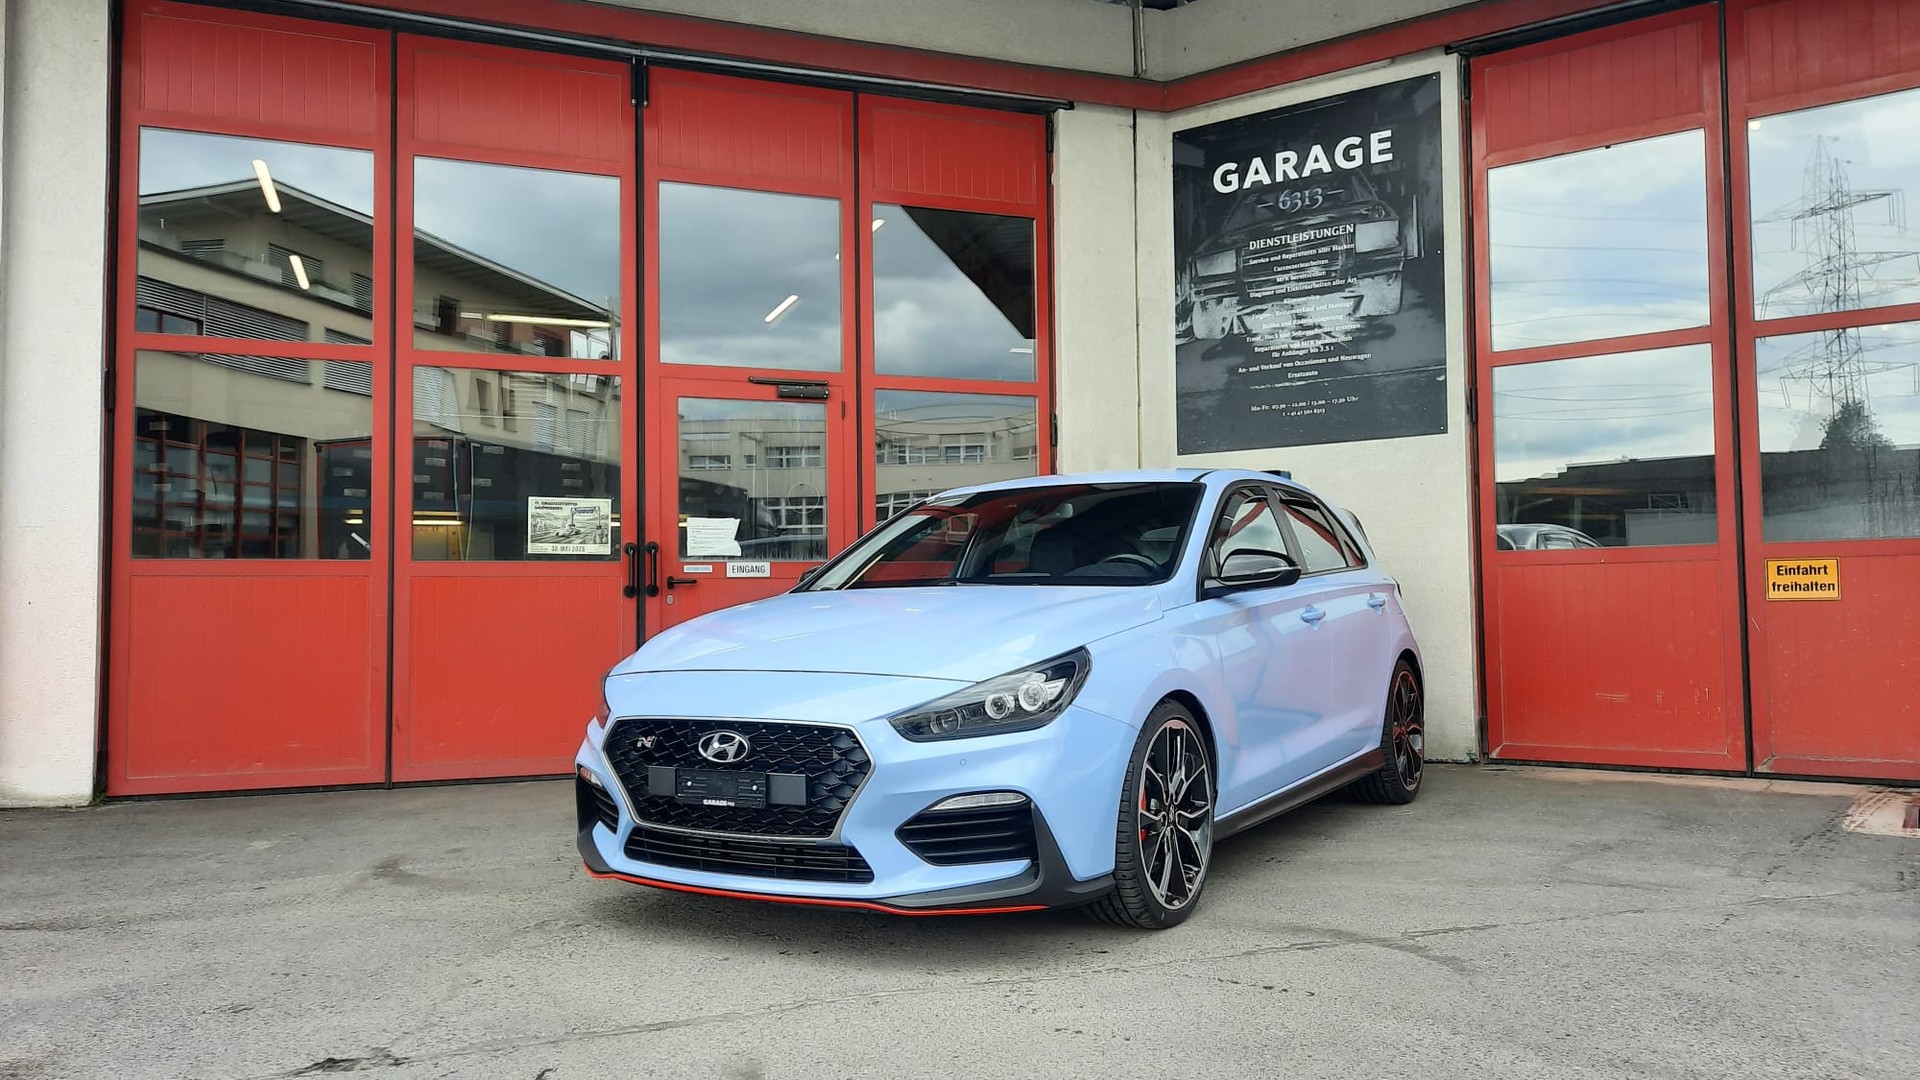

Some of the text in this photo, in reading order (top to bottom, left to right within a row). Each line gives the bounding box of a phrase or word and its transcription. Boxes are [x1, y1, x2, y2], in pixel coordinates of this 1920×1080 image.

[1212, 128, 1394, 195] GARAGE
[1278, 187, 1322, 214] 6313
[1248, 223, 1354, 251] DIENSTLEISTUNGEN
[1248, 243, 1354, 265] Service und Reparaturen aller Marken
[1250, 290, 1274, 299] Diagnose
[1275, 287, 1287, 295] und
[1332, 278, 1346, 286] aller
[1347, 276, 1358, 284] Art
[1254, 343, 1289, 353] Reparaturen
[1281, 349, 1309, 358] Anhänger
[1248, 364, 1260, 372] und
[1260, 361, 1282, 371] Verkauf
[1294, 357, 1327, 367] Occasionen
[1327, 355, 1339, 363] und
[1340, 353, 1372, 362] Neuwagen
[1287, 370, 1318, 379] Ersatzauto
[731, 565, 766, 574] EINGANG
[1776, 564, 1828, 576] Einfahrt
[1771, 581, 1836, 592] freihalten
